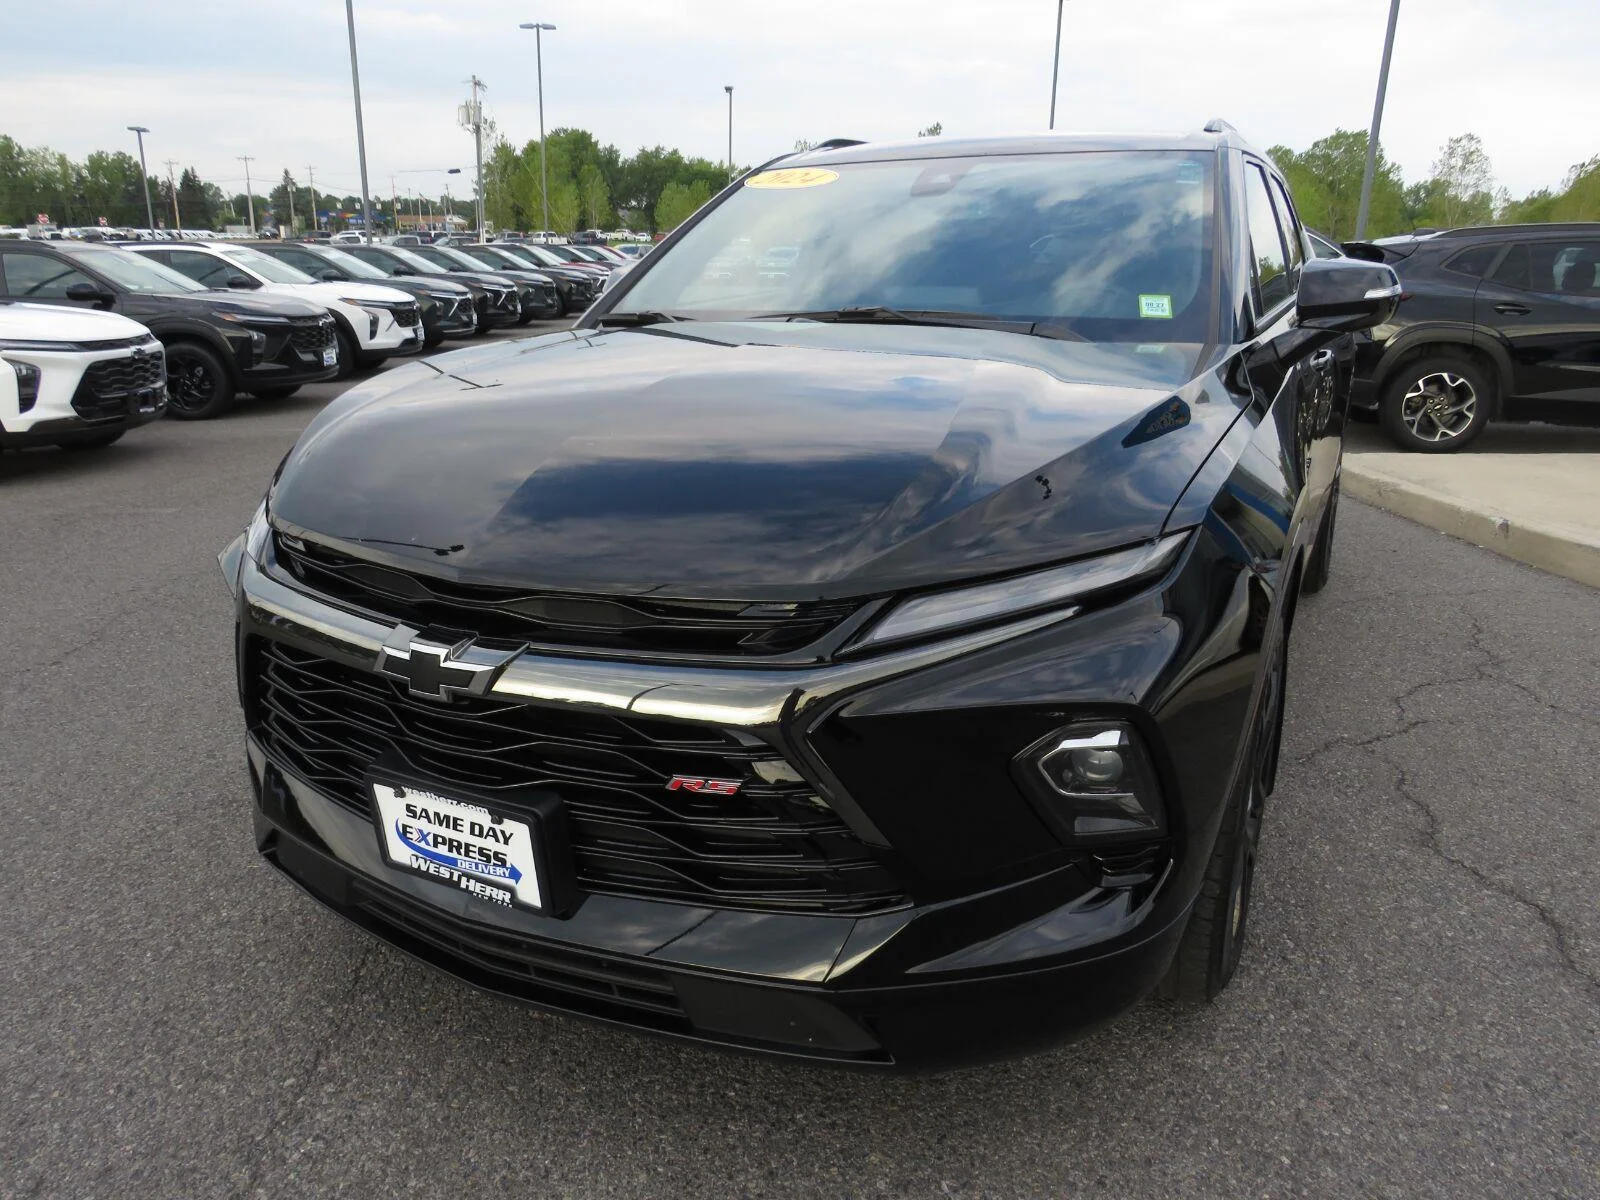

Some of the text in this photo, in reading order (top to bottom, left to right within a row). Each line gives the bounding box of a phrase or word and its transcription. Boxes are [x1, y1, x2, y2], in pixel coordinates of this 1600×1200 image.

[665, 777, 742, 795] RS
[401, 786, 488, 814] westherr.com
[405, 804, 514, 846] SAME DAY
[402, 823, 508, 868] EXPRESS
[457, 859, 510, 877] DELIVERY
[473, 892, 513, 909] NEW YORK
